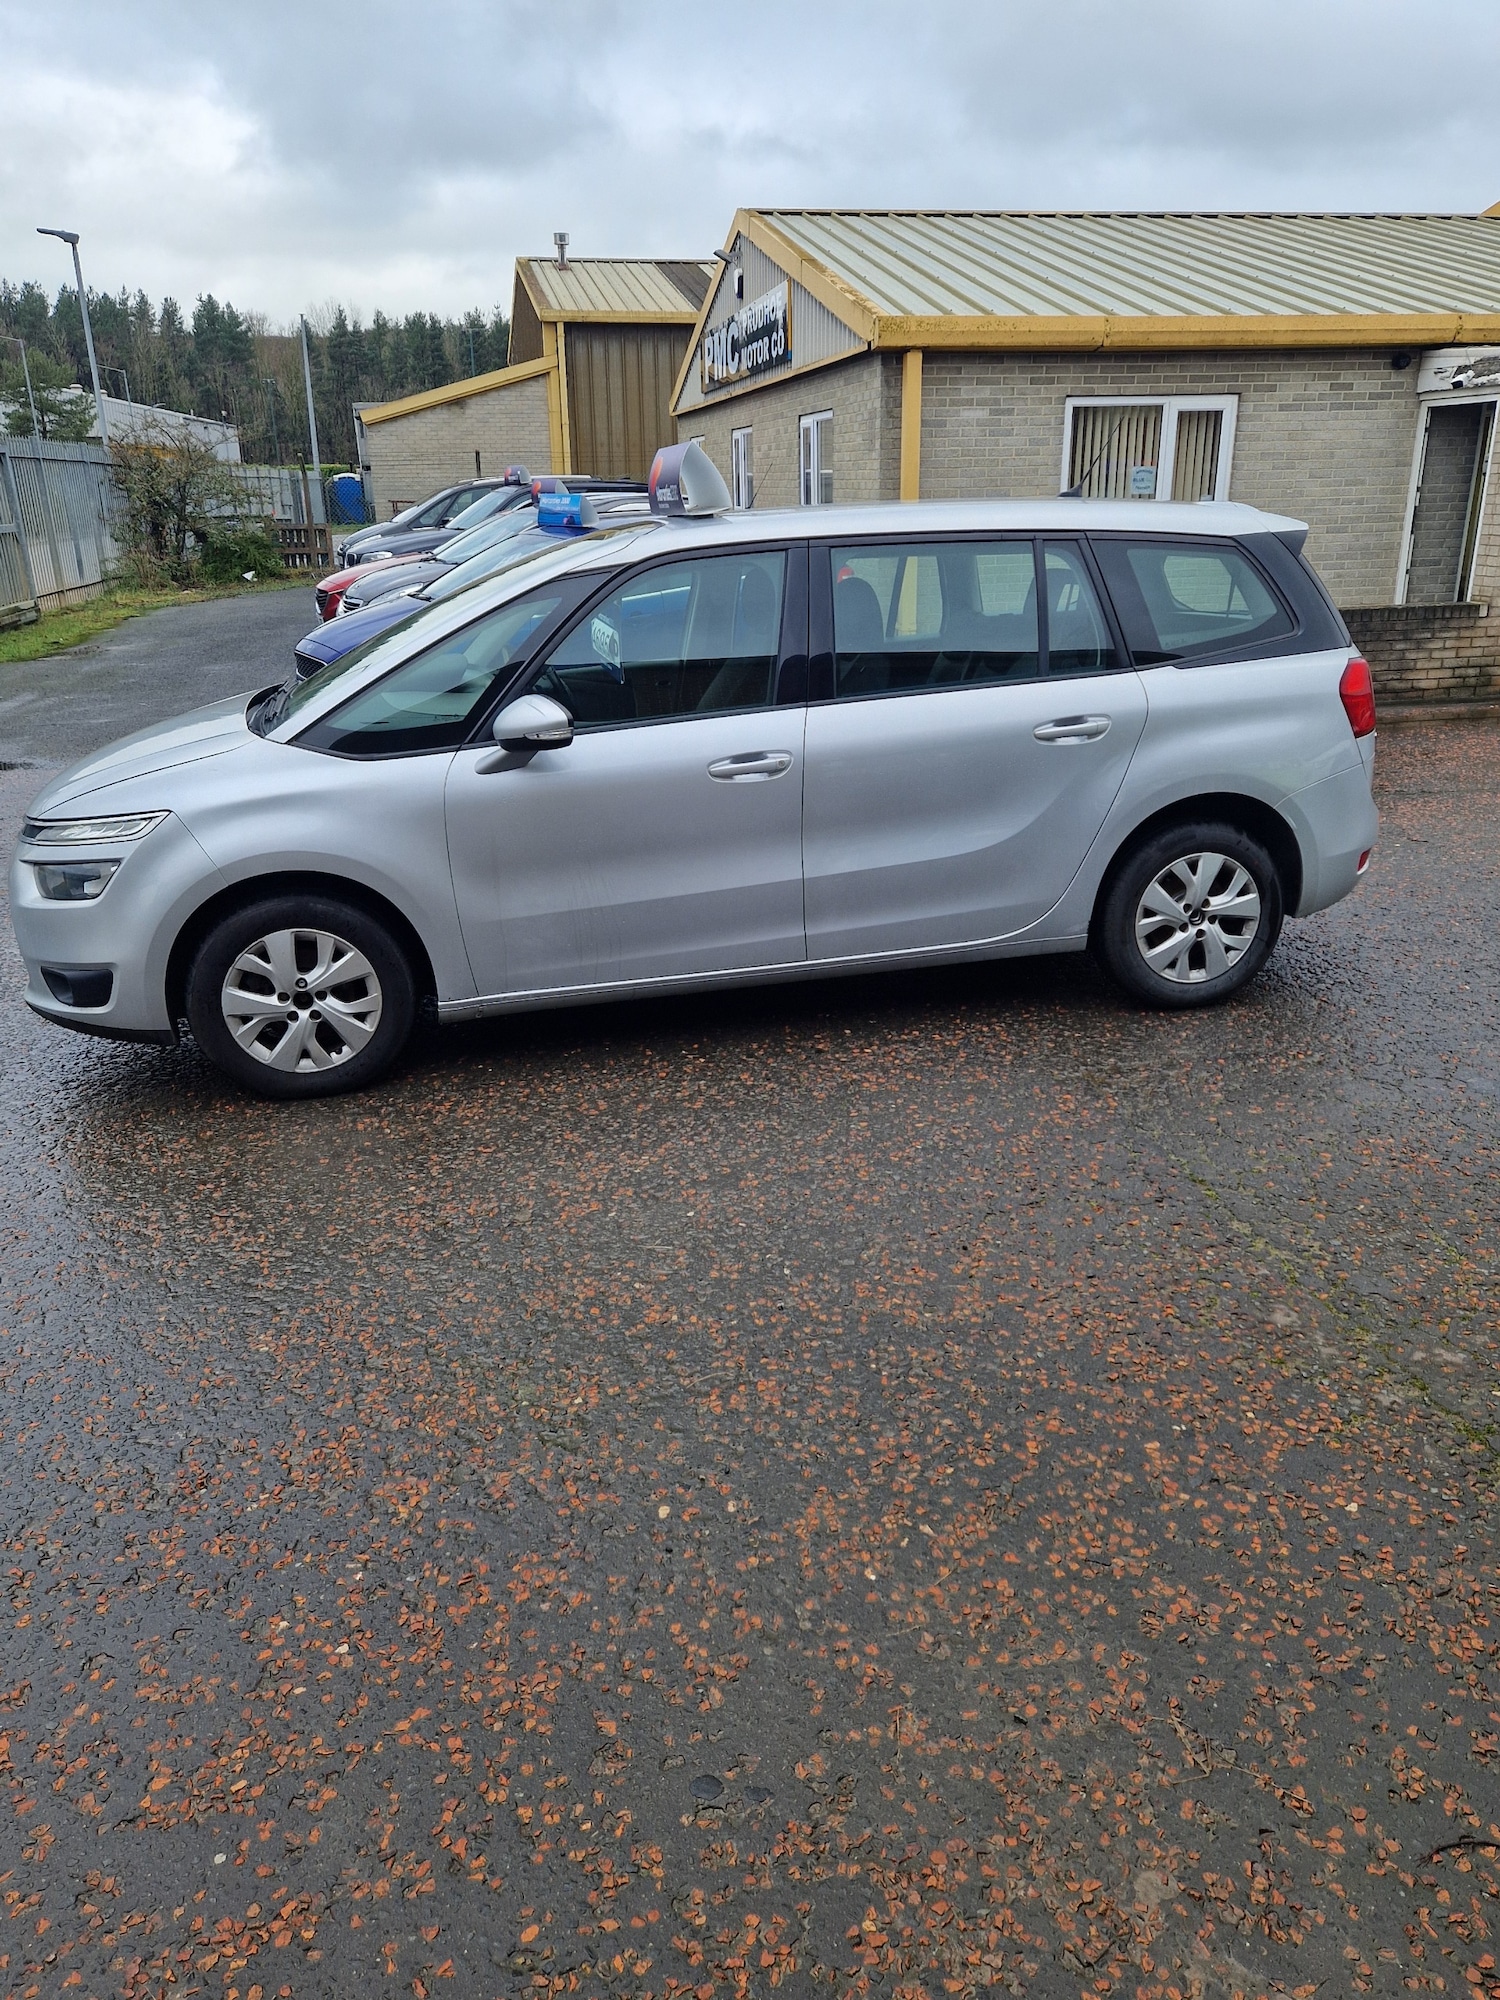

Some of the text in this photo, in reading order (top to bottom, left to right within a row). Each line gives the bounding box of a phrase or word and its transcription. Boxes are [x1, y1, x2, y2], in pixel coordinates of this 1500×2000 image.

[741, 291, 782, 338] PRUDHOE
[704, 322, 739, 384] PMC
[741, 329, 784, 370] MOTOR CO
